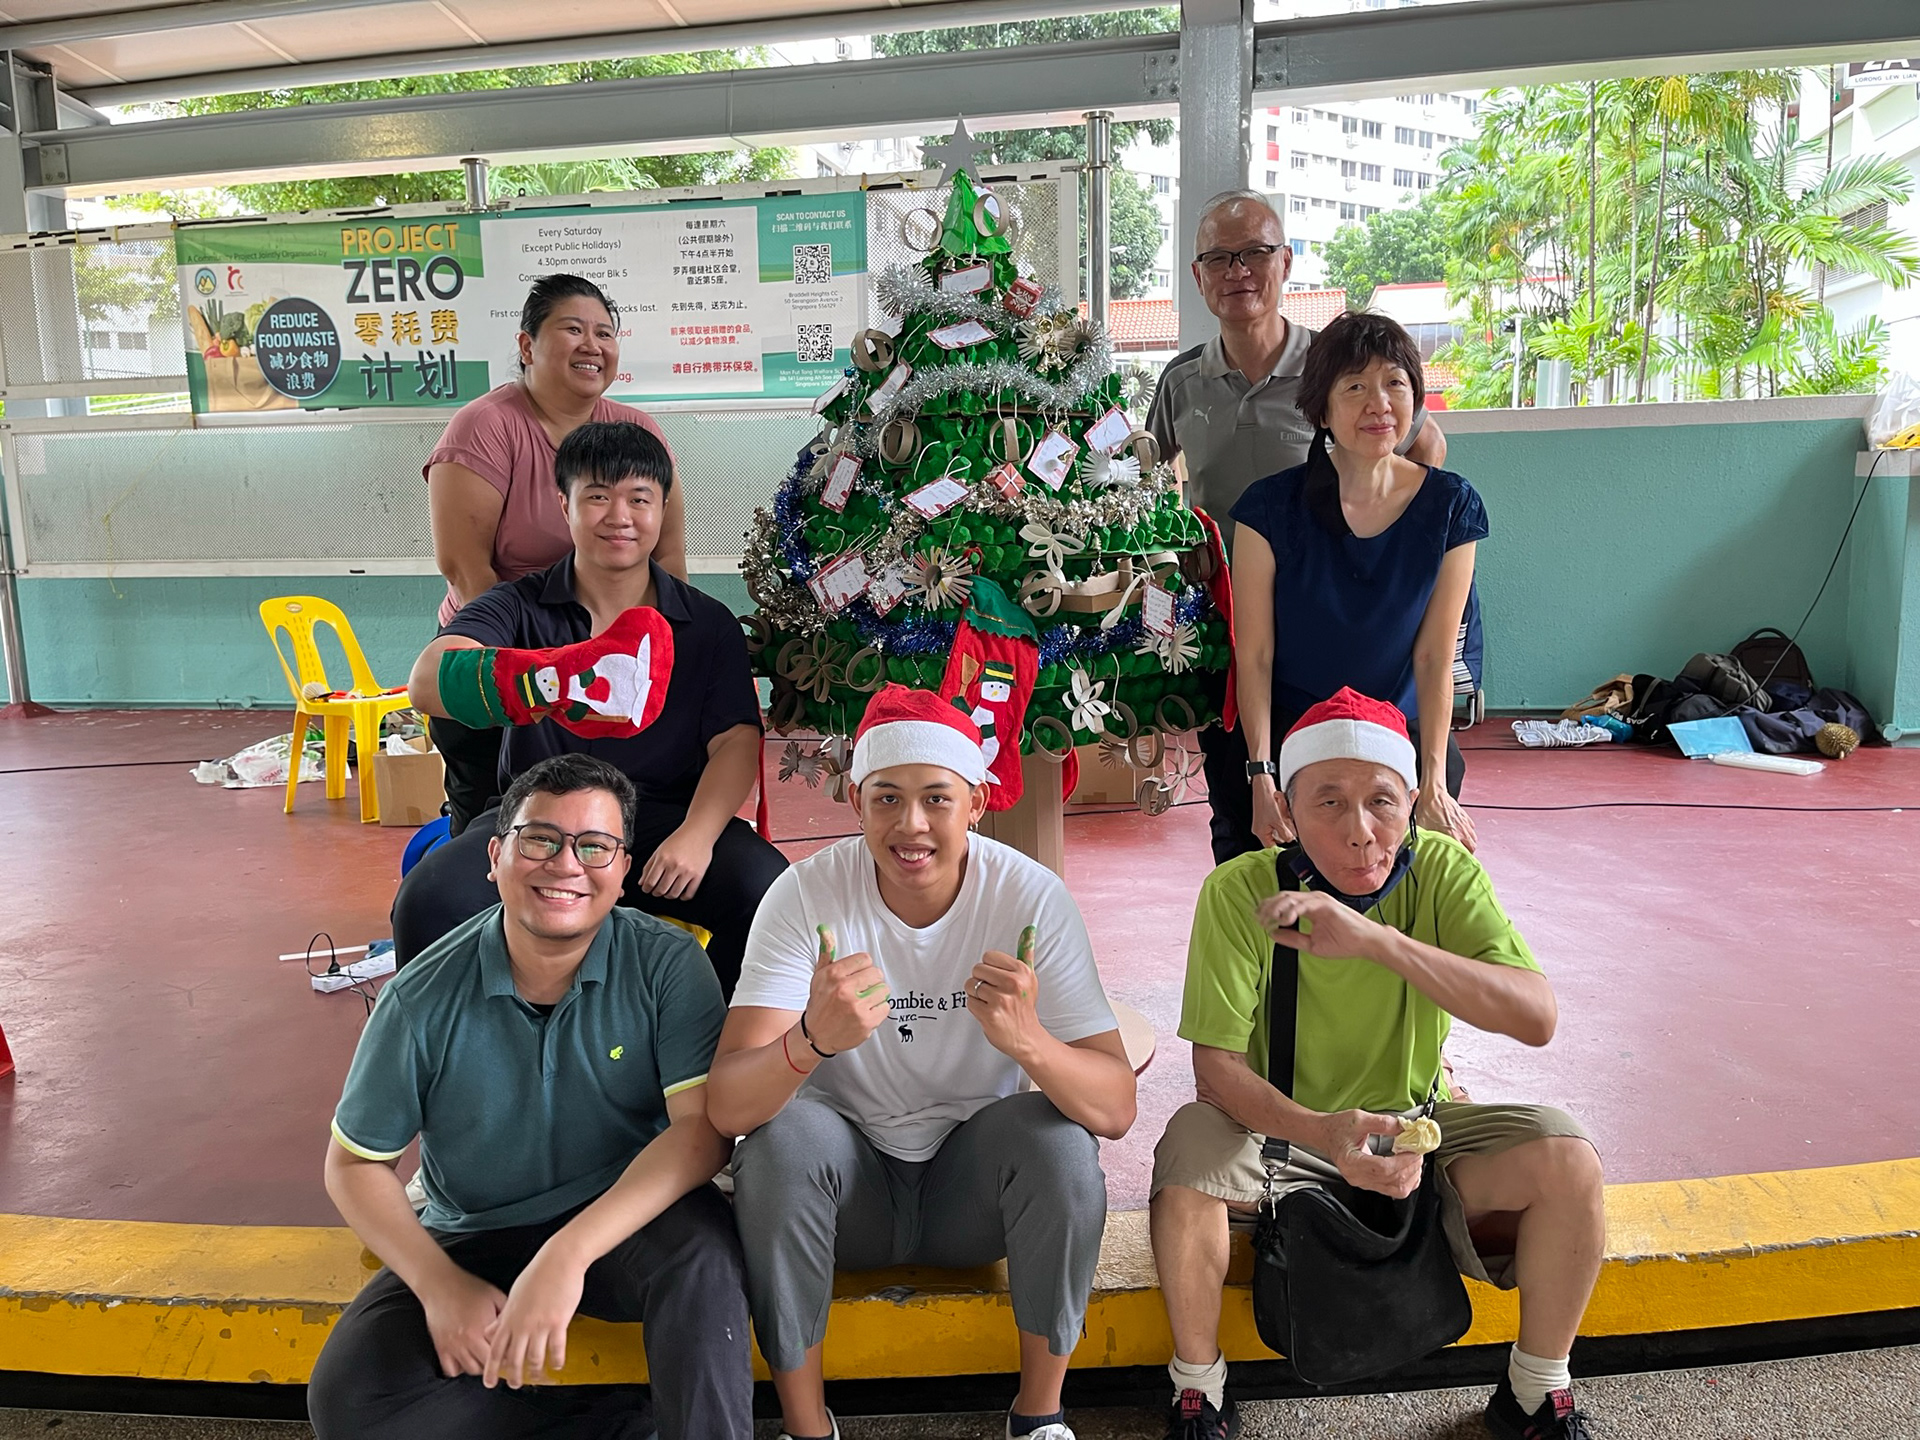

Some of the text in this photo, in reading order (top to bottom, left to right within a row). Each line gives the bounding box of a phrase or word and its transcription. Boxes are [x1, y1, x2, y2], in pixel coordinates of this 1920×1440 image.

[776, 213, 794, 221] SCAN
[805, 210, 835, 219] CONTACT
[836, 210, 846, 218] US
[686, 219, 726, 229] 每逢星期六
[341, 223, 460, 255] PROJECT
[538, 226, 602, 238] Every Saturday
[521, 239, 622, 253] (Except Public Holidays)
[234, 252, 257, 262] Project
[258, 250, 281, 260] Jointly
[318, 249, 327, 258] by
[680, 248, 734, 259] 下午4点半开始
[538, 255, 607, 267] 4.30pm onwards
[342, 254, 464, 304] ZERO
[586, 271, 602, 279] near
[607, 269, 620, 278] Blk
[622, 269, 628, 277] 5
[490, 310, 508, 318] First
[640, 304, 658, 312] last.
[270, 313, 319, 329] REDUCE
[354, 309, 460, 347] 零耗费
[258, 331, 336, 348] FOOD WASTE
[269, 350, 329, 370] 减少食物
[286, 371, 315, 390] 浪费
[359, 349, 458, 401] 计划
[938, 997, 948, 1011] &
